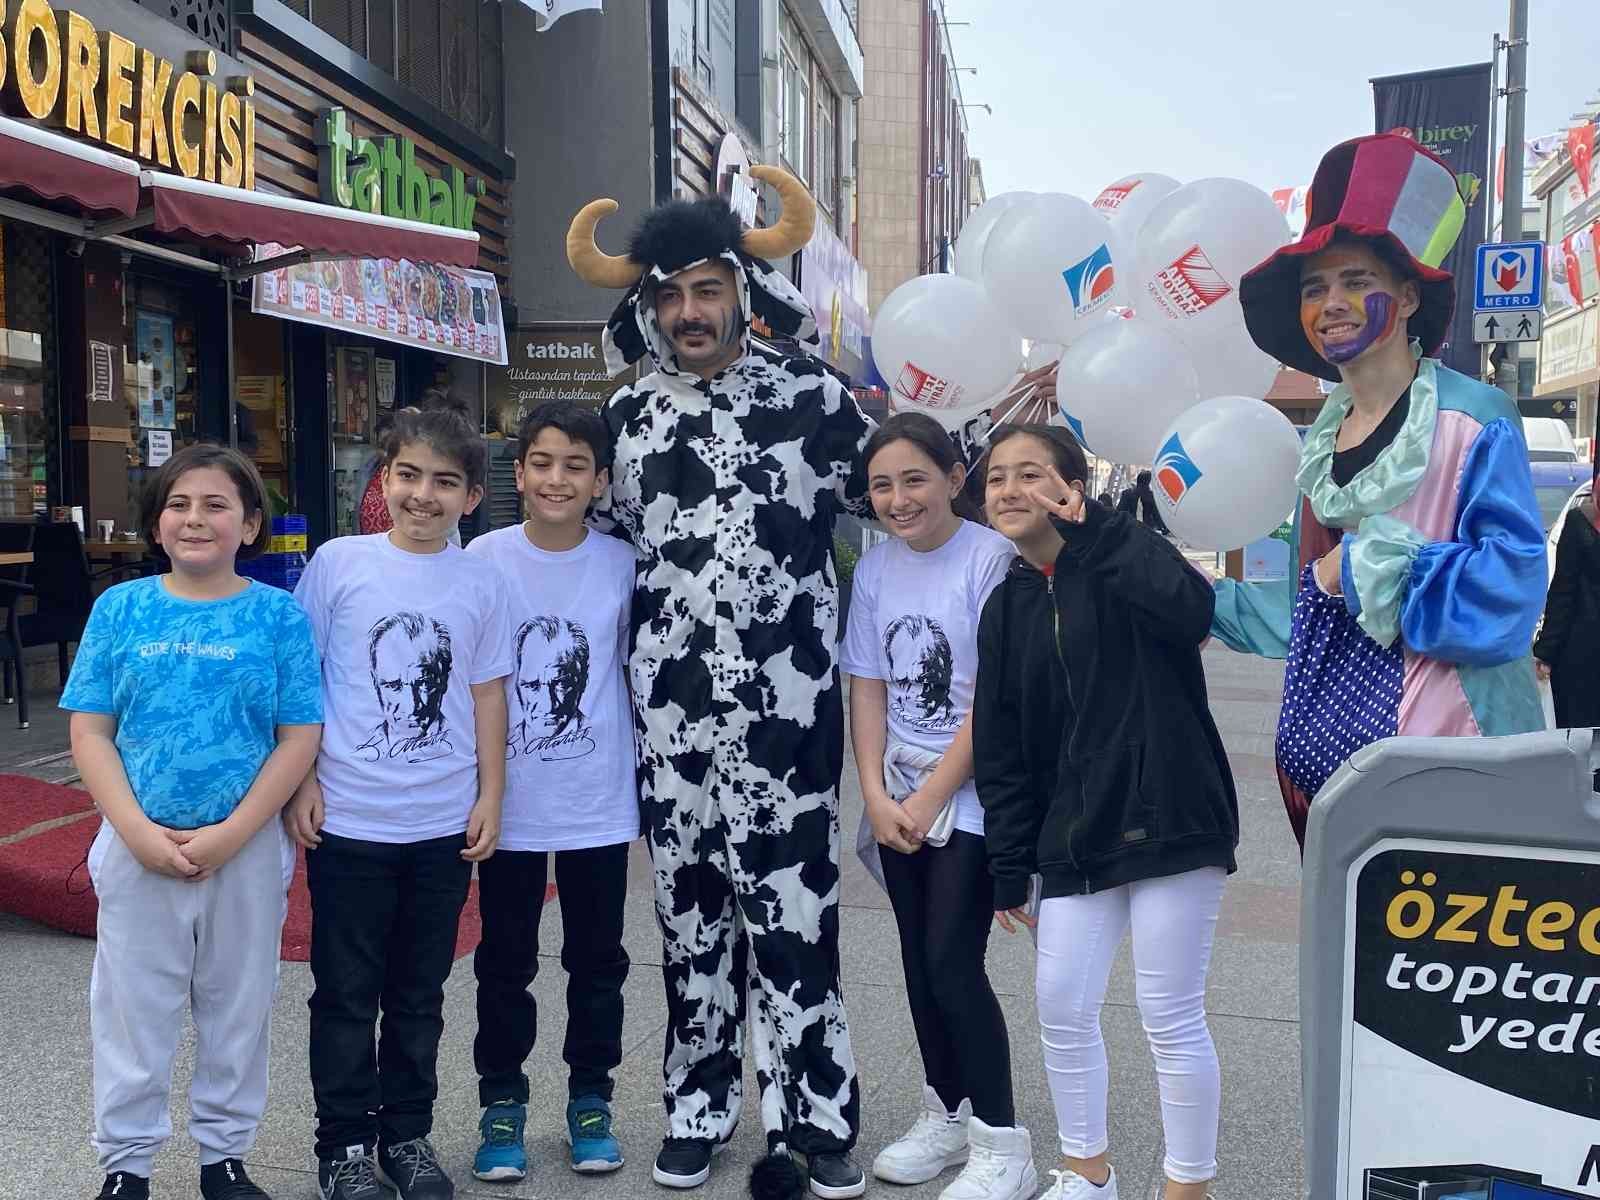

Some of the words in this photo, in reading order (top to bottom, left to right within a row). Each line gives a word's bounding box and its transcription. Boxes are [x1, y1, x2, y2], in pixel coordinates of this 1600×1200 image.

[1416, 125, 1478, 144] birey
[326, 106, 476, 231] tatbak
[1158, 271, 1197, 314] POYRAZ
[1484, 295, 1530, 307] METRO
[526, 342, 597, 359] tatbak
[507, 367, 571, 381] Ustasından
[573, 366, 615, 386] taptaz
[518, 387, 557, 402] günlük
[557, 388, 601, 401] baklava
[174, 641, 195, 656] THE
[197, 643, 236, 661] WAVES
